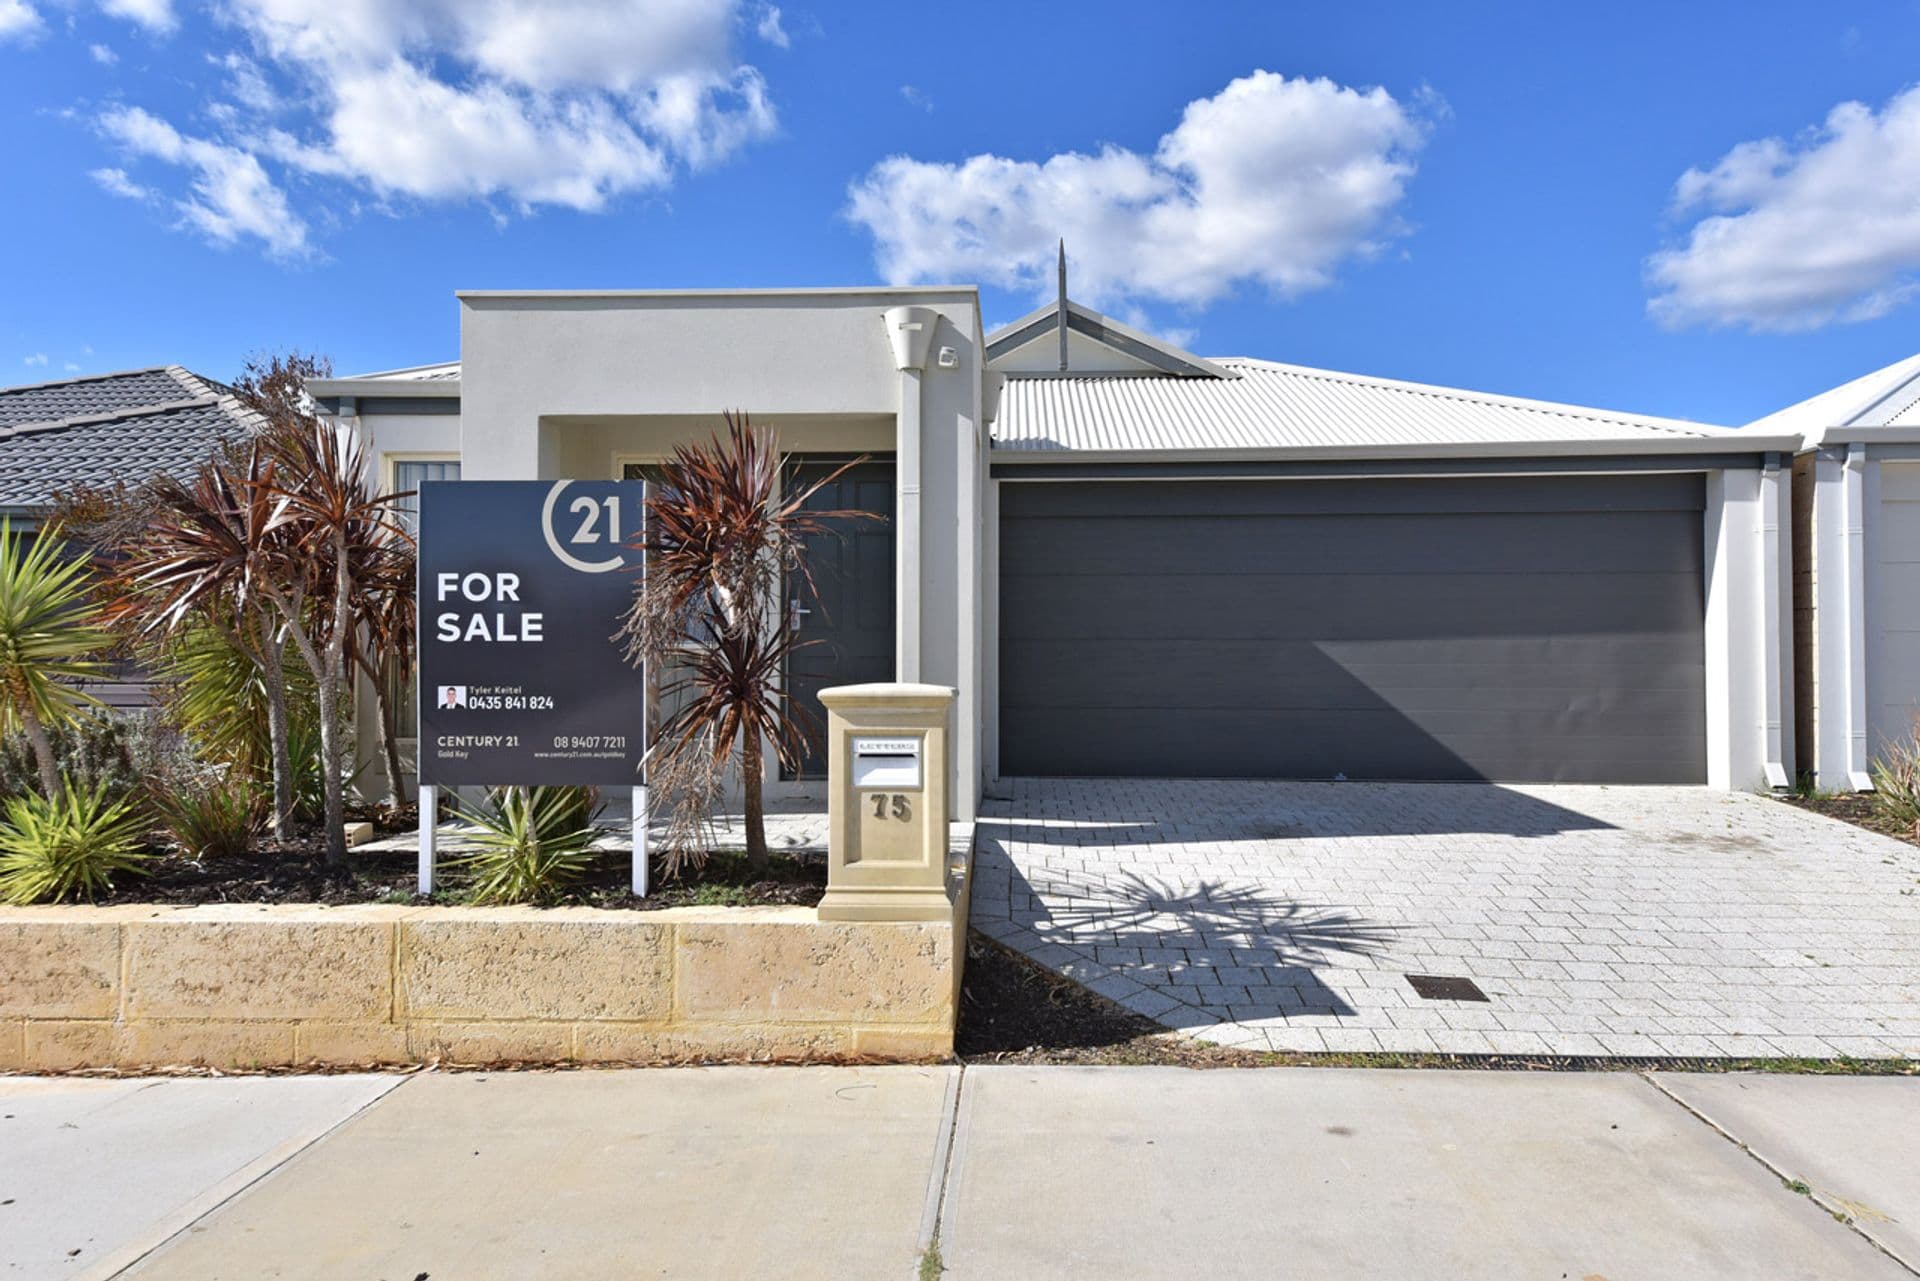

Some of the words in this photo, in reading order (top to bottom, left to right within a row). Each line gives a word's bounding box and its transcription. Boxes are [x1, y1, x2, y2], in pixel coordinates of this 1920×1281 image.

[569, 496, 620, 544] 21
[437, 572, 520, 602] FOR
[437, 612, 544, 642] SALE
[469, 686, 492, 696] Tyler
[469, 695, 502, 710] 0435
[505, 695, 527, 710] 841
[529, 695, 554, 710] 824
[437, 735, 502, 747] CENTURY
[505, 735, 519, 747] 21
[553, 735, 569, 749] 08
[571, 735, 600, 749] 9407
[602, 735, 626, 749] 7211
[437, 750, 454, 759] Gold
[455, 750, 469, 760] Key
[870, 793, 909, 819] 75
